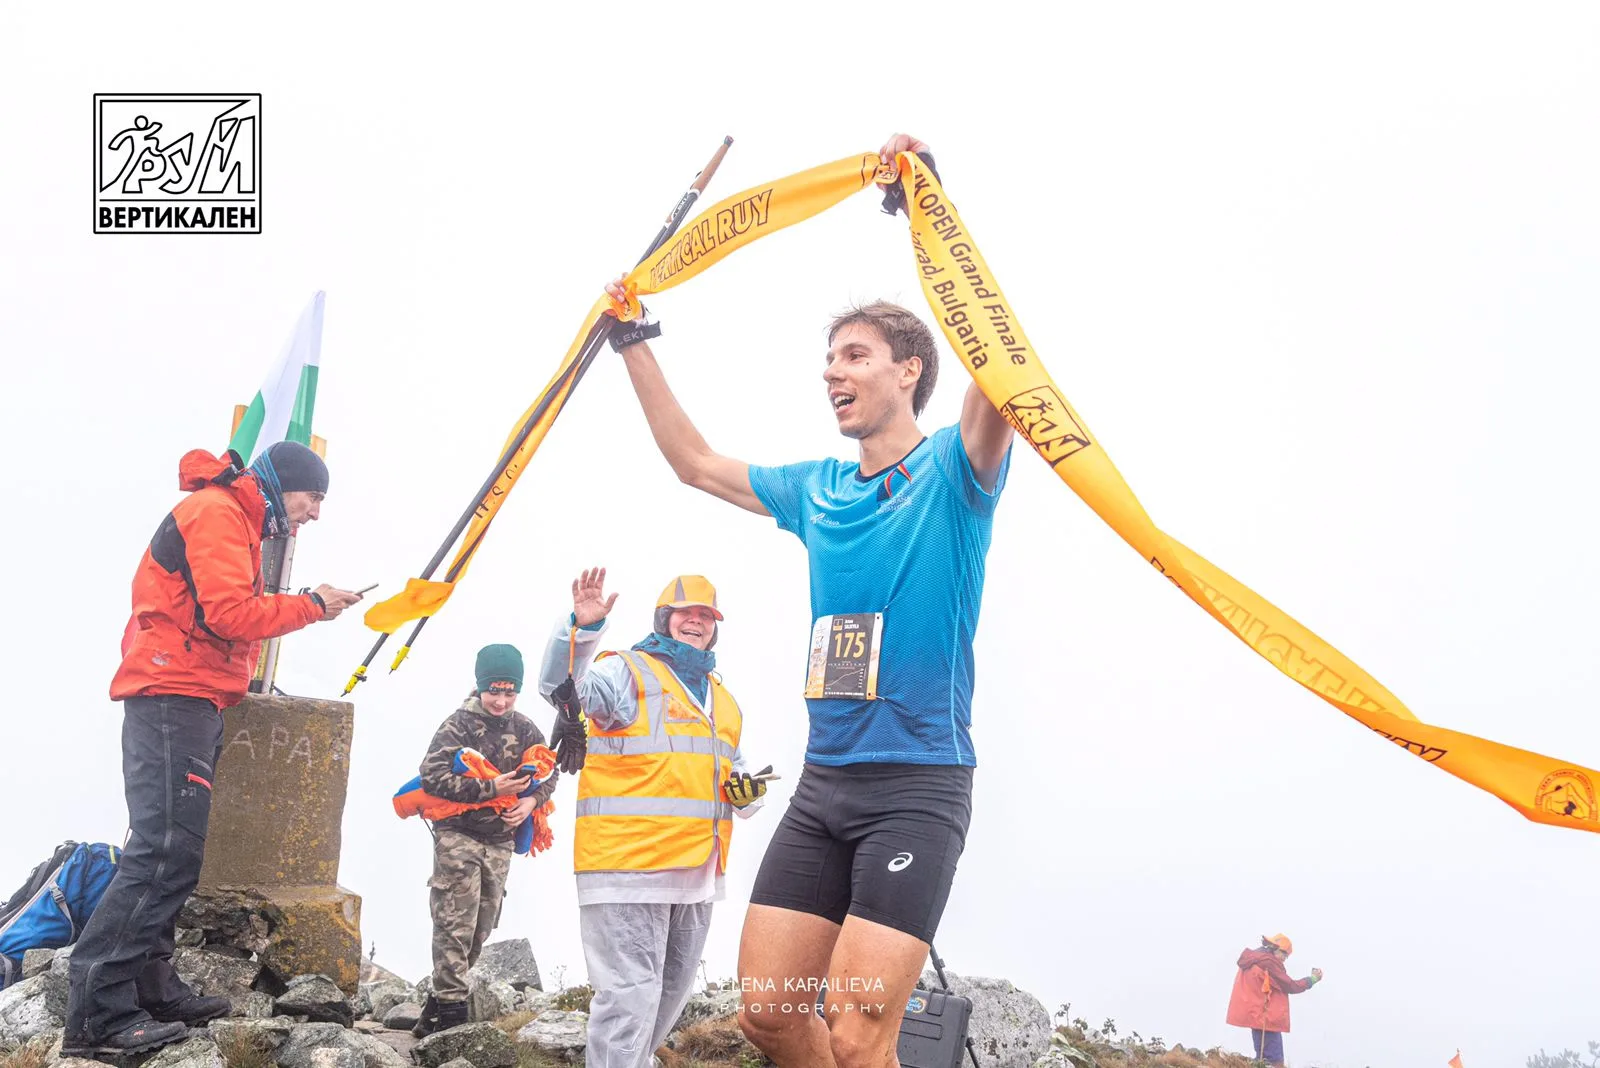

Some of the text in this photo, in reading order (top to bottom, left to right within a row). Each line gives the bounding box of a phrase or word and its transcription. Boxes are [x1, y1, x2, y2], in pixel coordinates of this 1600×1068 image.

[715, 188, 773, 245] RUY
[918, 192, 962, 242] OPEN
[948, 242, 998, 300] Grand
[982, 303, 1027, 366] Finale
[615, 329, 645, 347] LEKI
[931, 279, 990, 370] Bulgaria
[833, 631, 867, 659] 175
